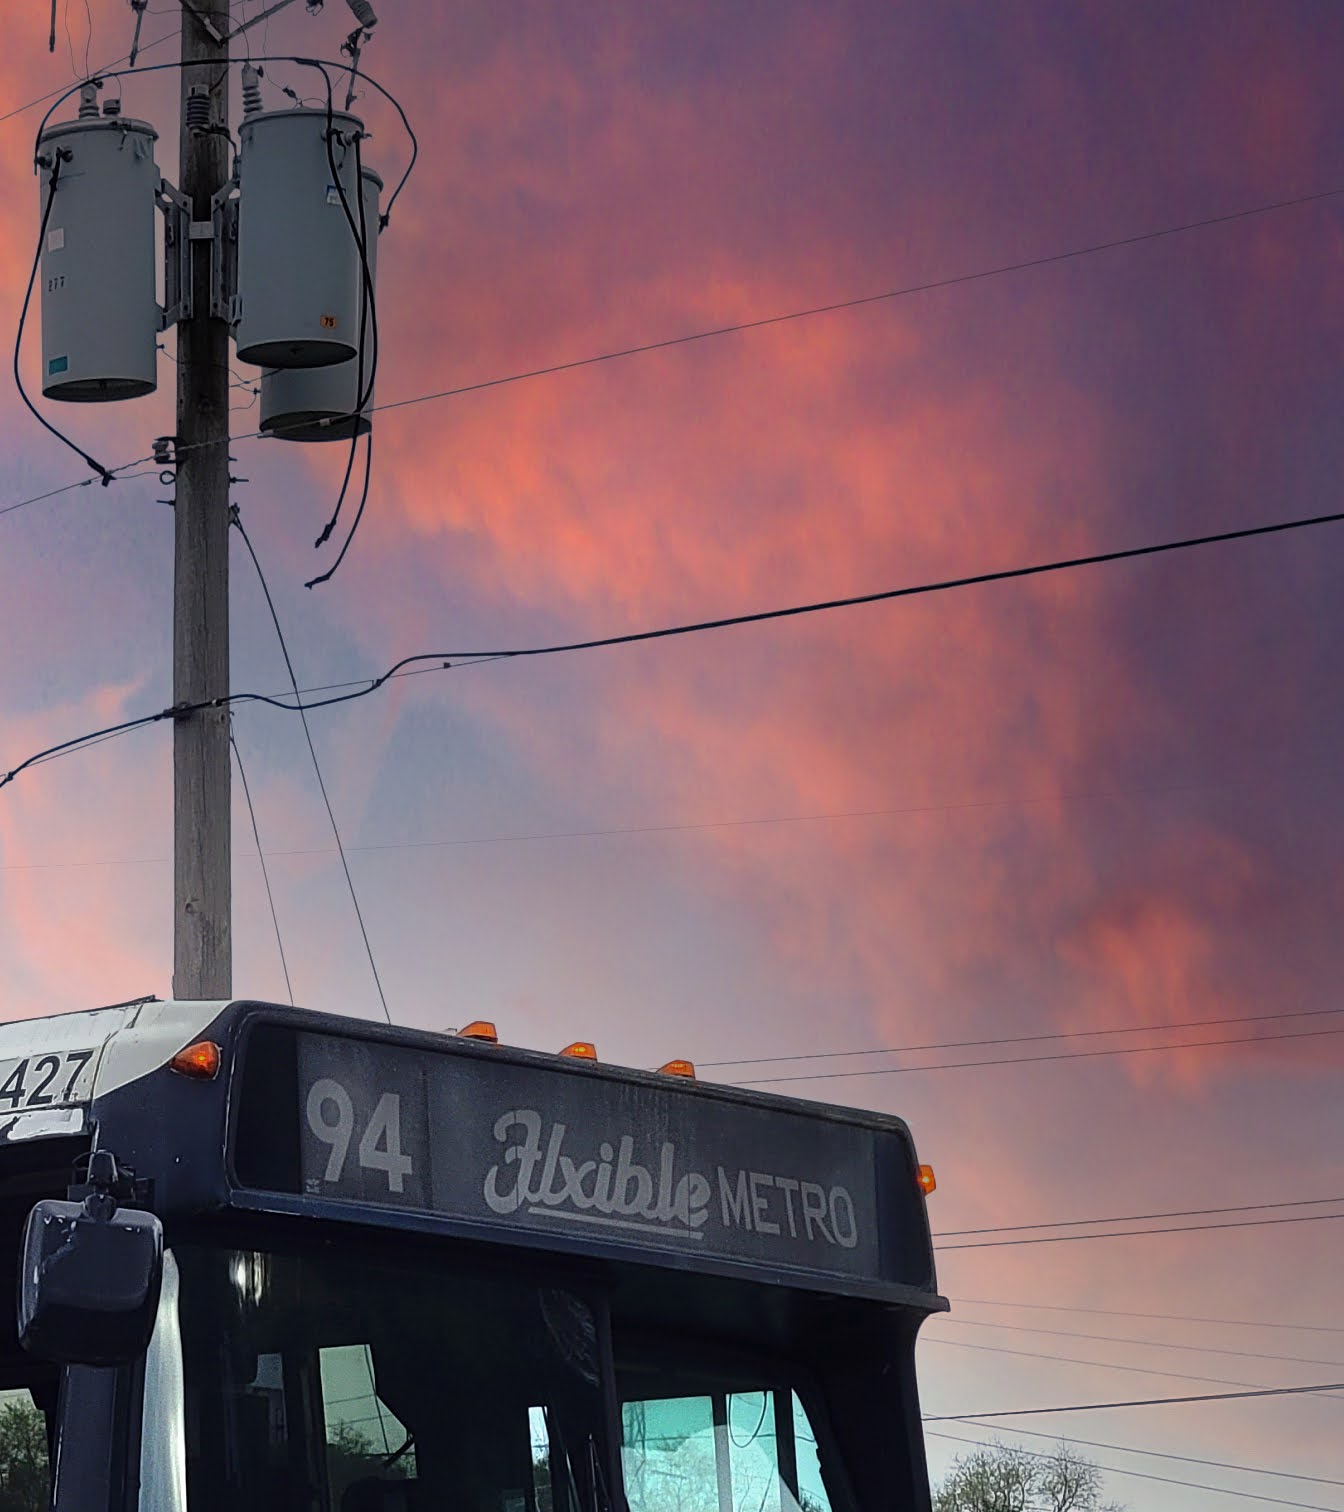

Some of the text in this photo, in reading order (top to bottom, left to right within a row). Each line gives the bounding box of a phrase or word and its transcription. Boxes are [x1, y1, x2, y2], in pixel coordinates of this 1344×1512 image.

[306, 1078, 858, 1249] 94 Flxible METRO
